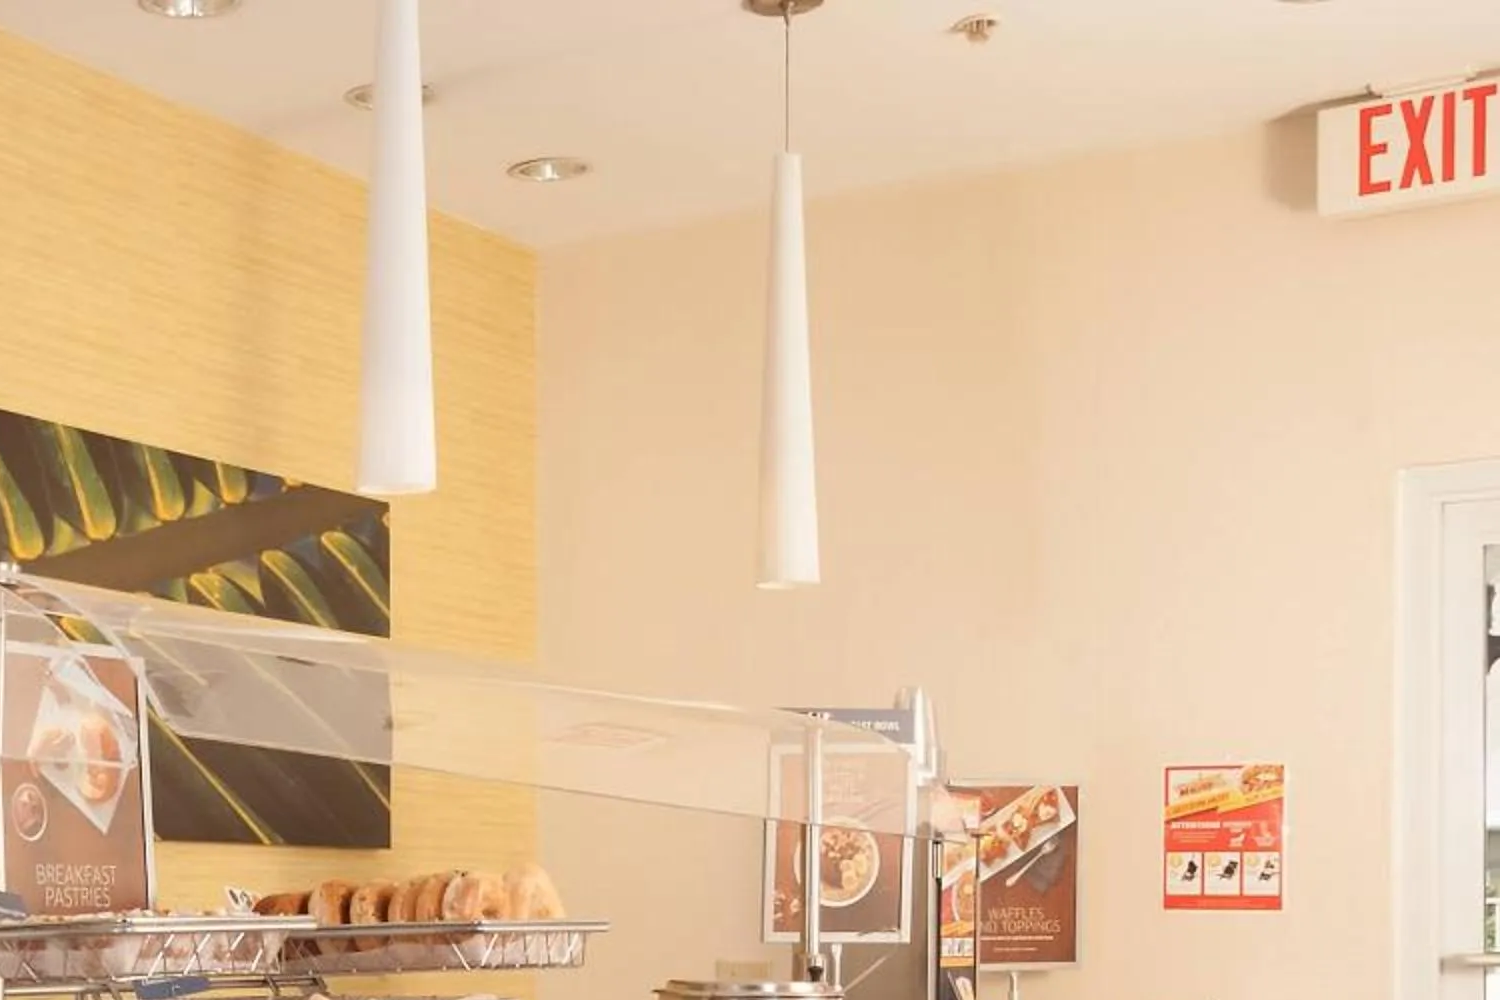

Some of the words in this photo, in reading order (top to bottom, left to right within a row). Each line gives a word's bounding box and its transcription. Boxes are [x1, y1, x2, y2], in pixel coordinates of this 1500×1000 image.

[1359, 83, 1497, 196] EXIT
[35, 863, 117, 885] BREAKFAST
[44, 887, 111, 908] PASTRIES
[987, 906, 1045, 920] WAFFLES
[1002, 919, 1061, 933] TOPPINGS
